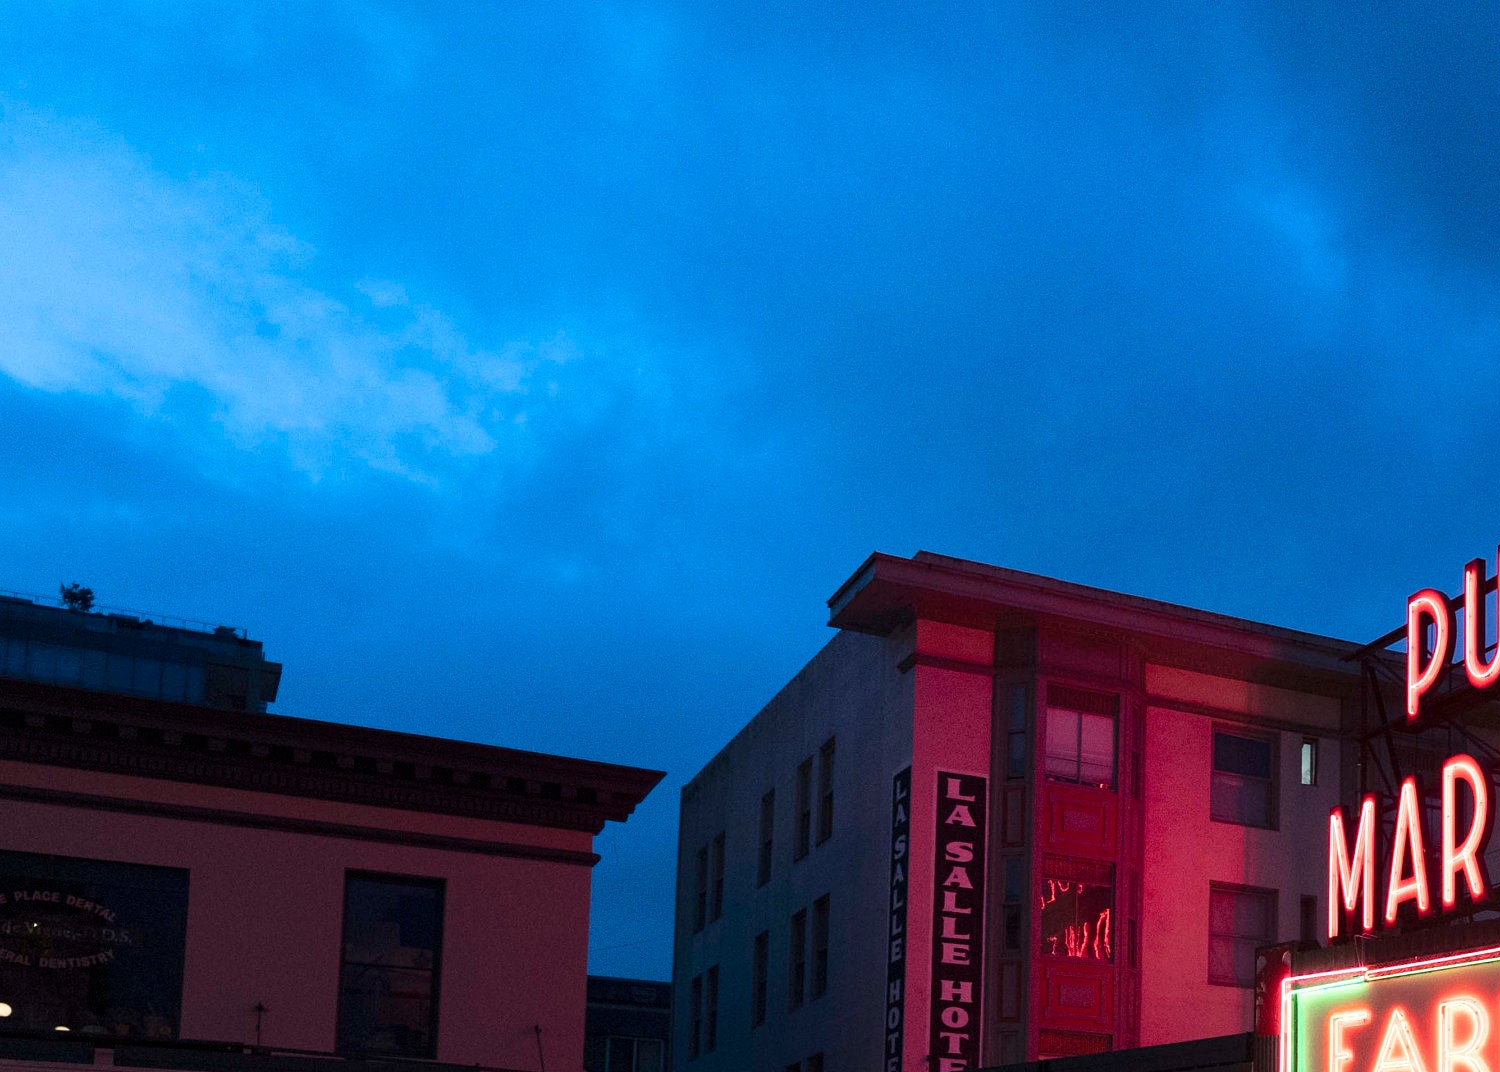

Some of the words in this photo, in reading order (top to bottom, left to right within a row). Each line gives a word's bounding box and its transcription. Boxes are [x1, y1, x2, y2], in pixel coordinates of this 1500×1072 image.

[895, 780, 907, 828] LA
[944, 777, 977, 828] LA
[14, 890, 62, 903] PLACE
[66, 894, 116, 923] DENTAL
[891, 835, 905, 962] SALLE
[940, 842, 975, 965] SALLE
[39, 947, 115, 968] DENTISTRY
